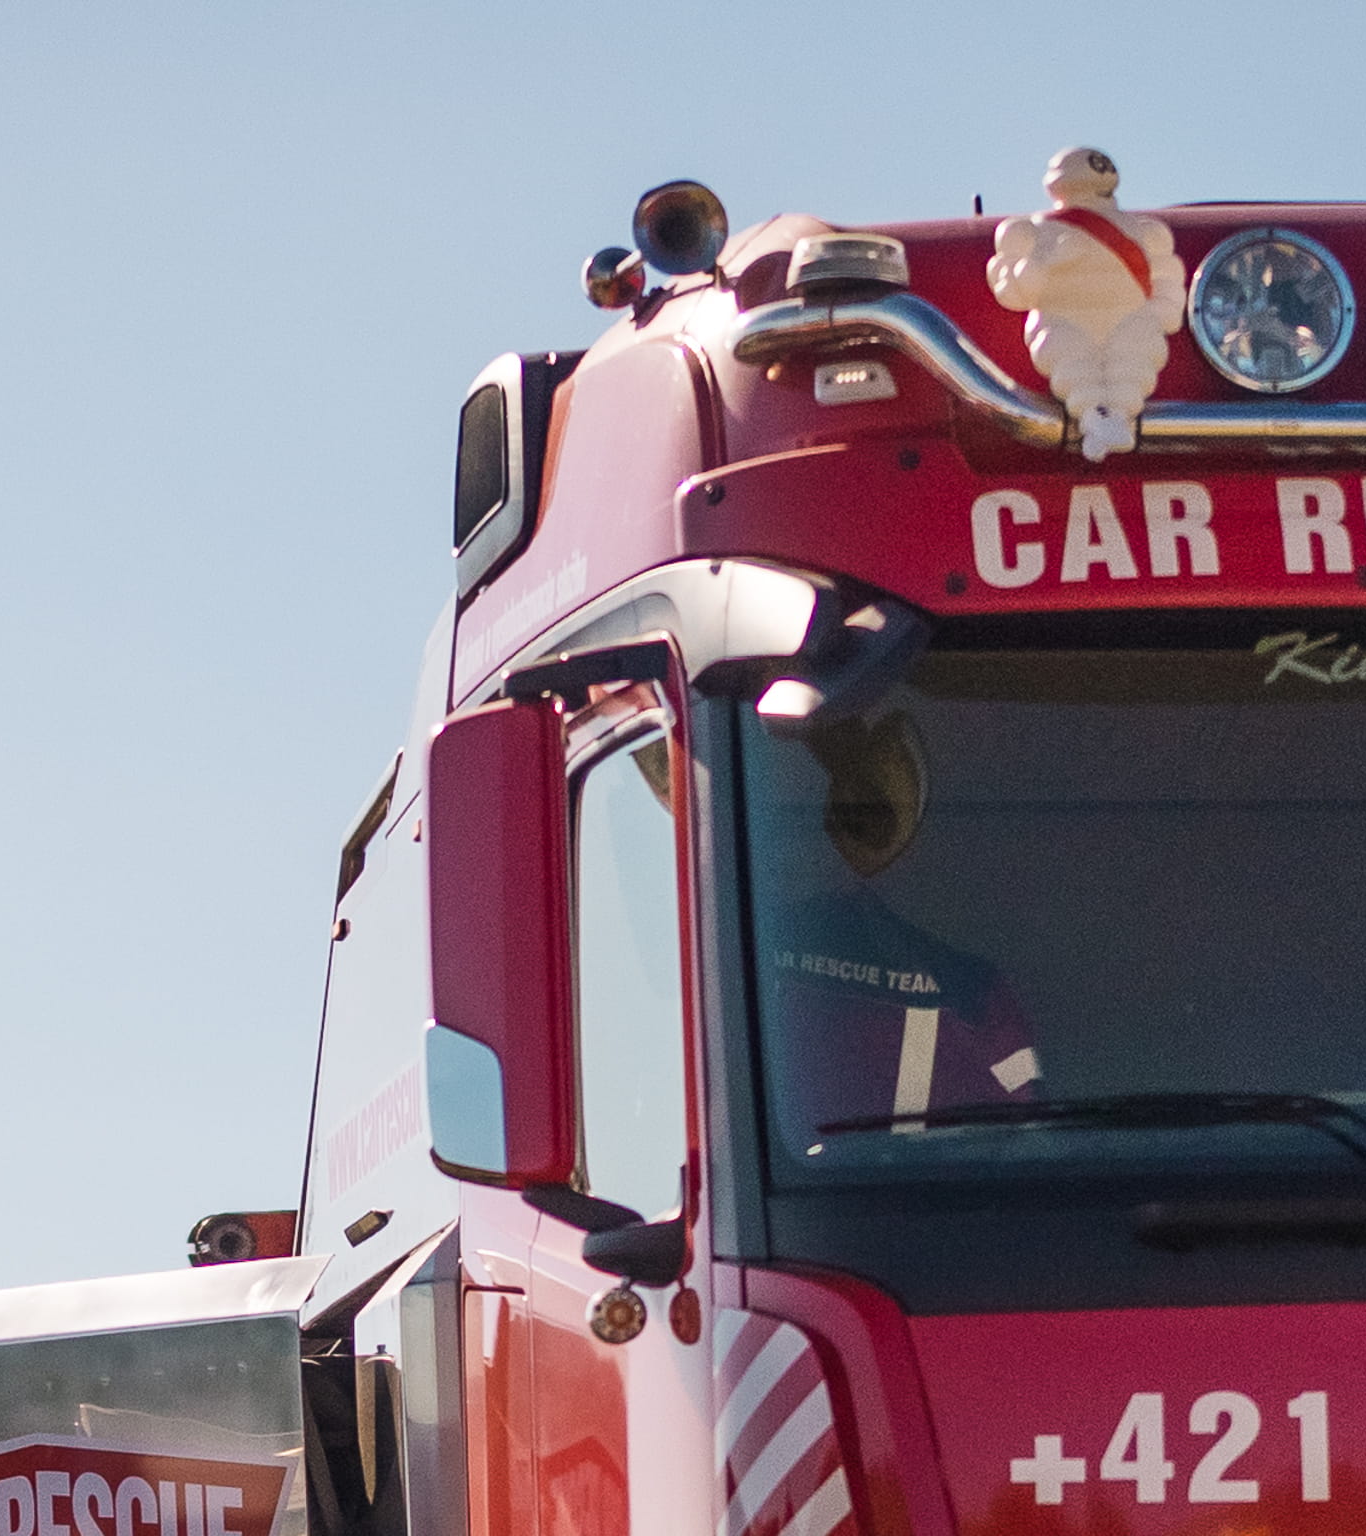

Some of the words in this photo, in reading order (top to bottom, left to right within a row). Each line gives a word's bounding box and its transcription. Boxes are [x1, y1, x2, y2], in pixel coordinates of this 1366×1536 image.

[972, 480, 1221, 590] CAR
[800, 953, 881, 987] RESCUE
[1011, 1391, 1331, 1506] +421
